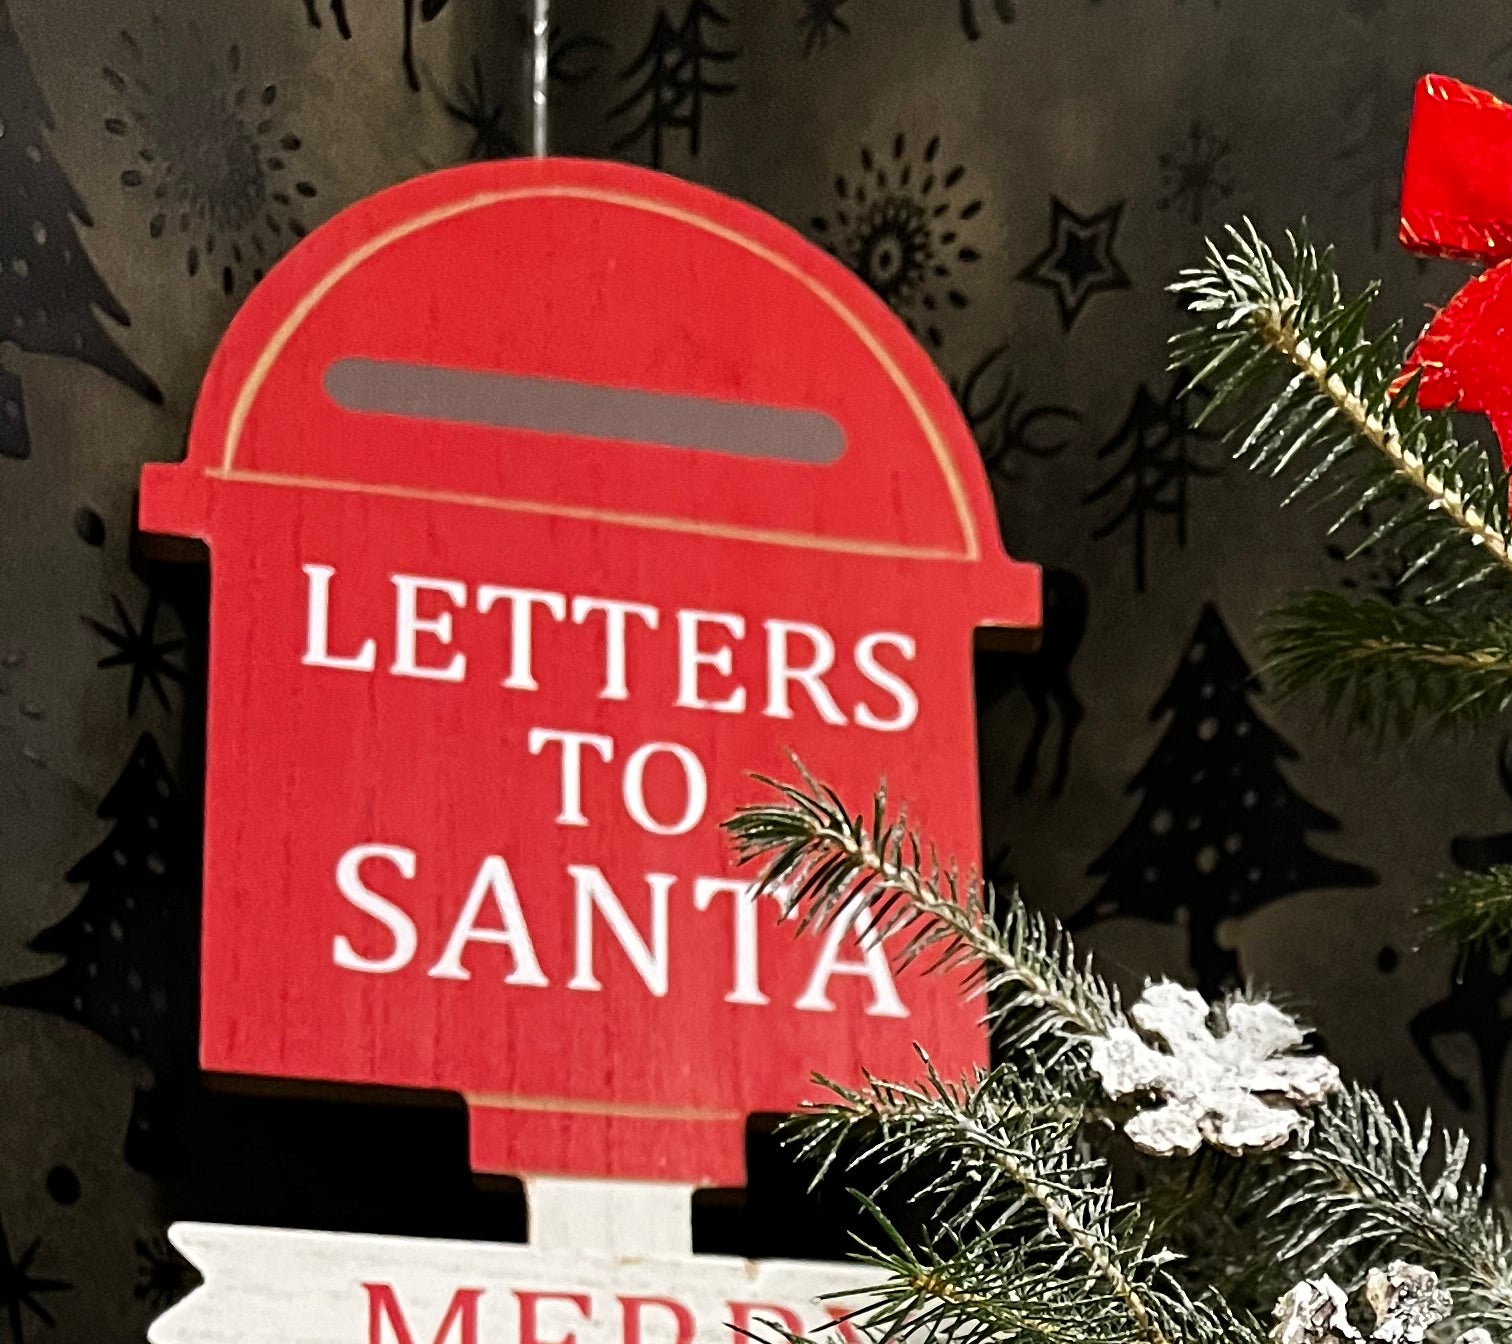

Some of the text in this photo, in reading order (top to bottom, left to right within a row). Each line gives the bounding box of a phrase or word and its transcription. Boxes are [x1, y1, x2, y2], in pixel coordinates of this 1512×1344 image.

[301, 563, 919, 731] LETTERS
[528, 726, 708, 835] TO
[331, 843, 911, 1019] SANTA
